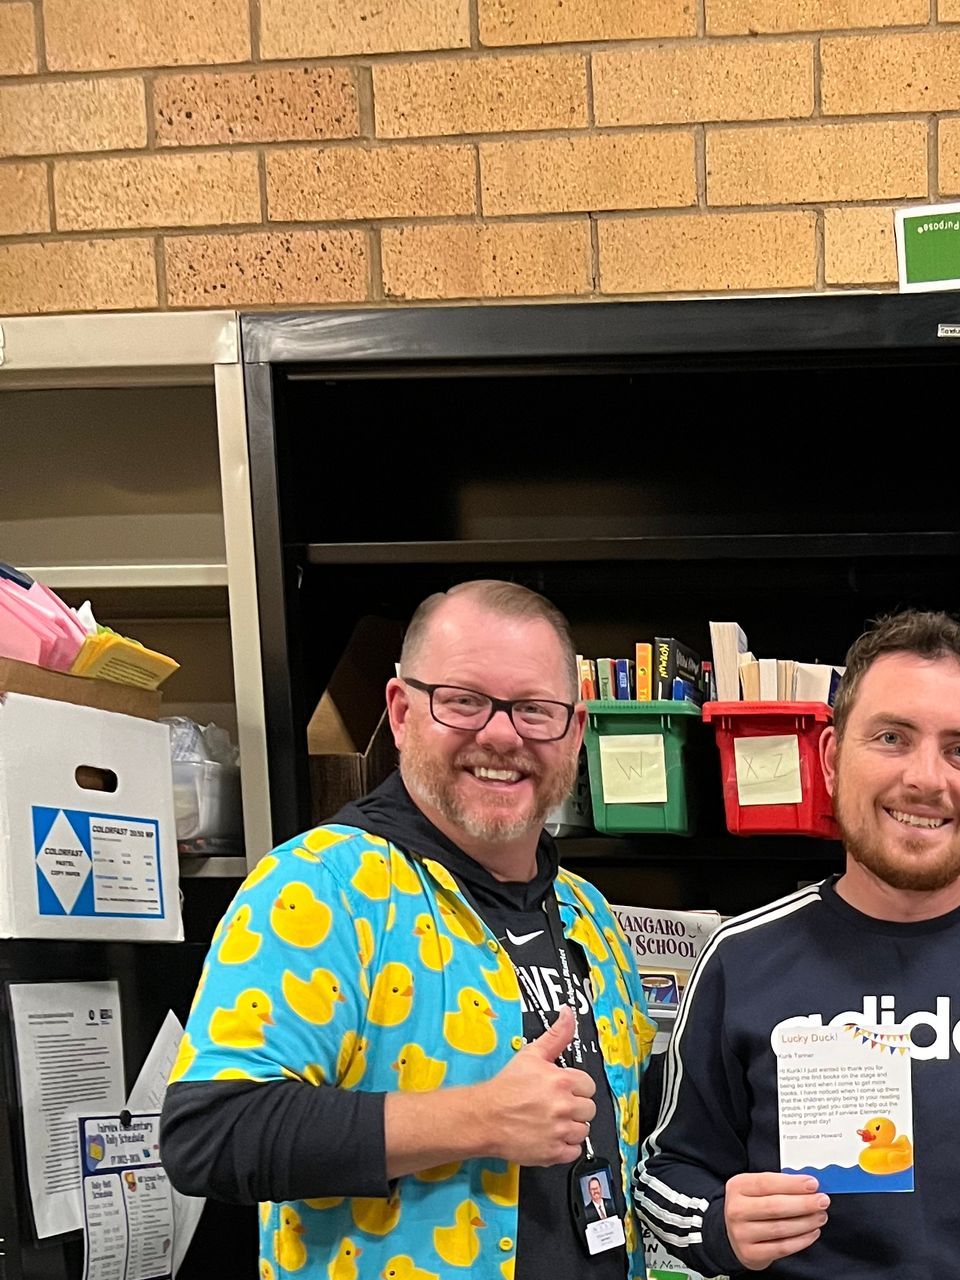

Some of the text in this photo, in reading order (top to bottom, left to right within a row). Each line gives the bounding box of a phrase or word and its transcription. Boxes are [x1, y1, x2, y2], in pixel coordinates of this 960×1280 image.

[615, 751, 643, 781] W
[742, 753, 788, 780] X-Z
[613, 911, 697, 939] KANGARO
[636, 935, 698, 958] SCHOOL
[781, 1032, 838, 1044] Lucky Duck!
